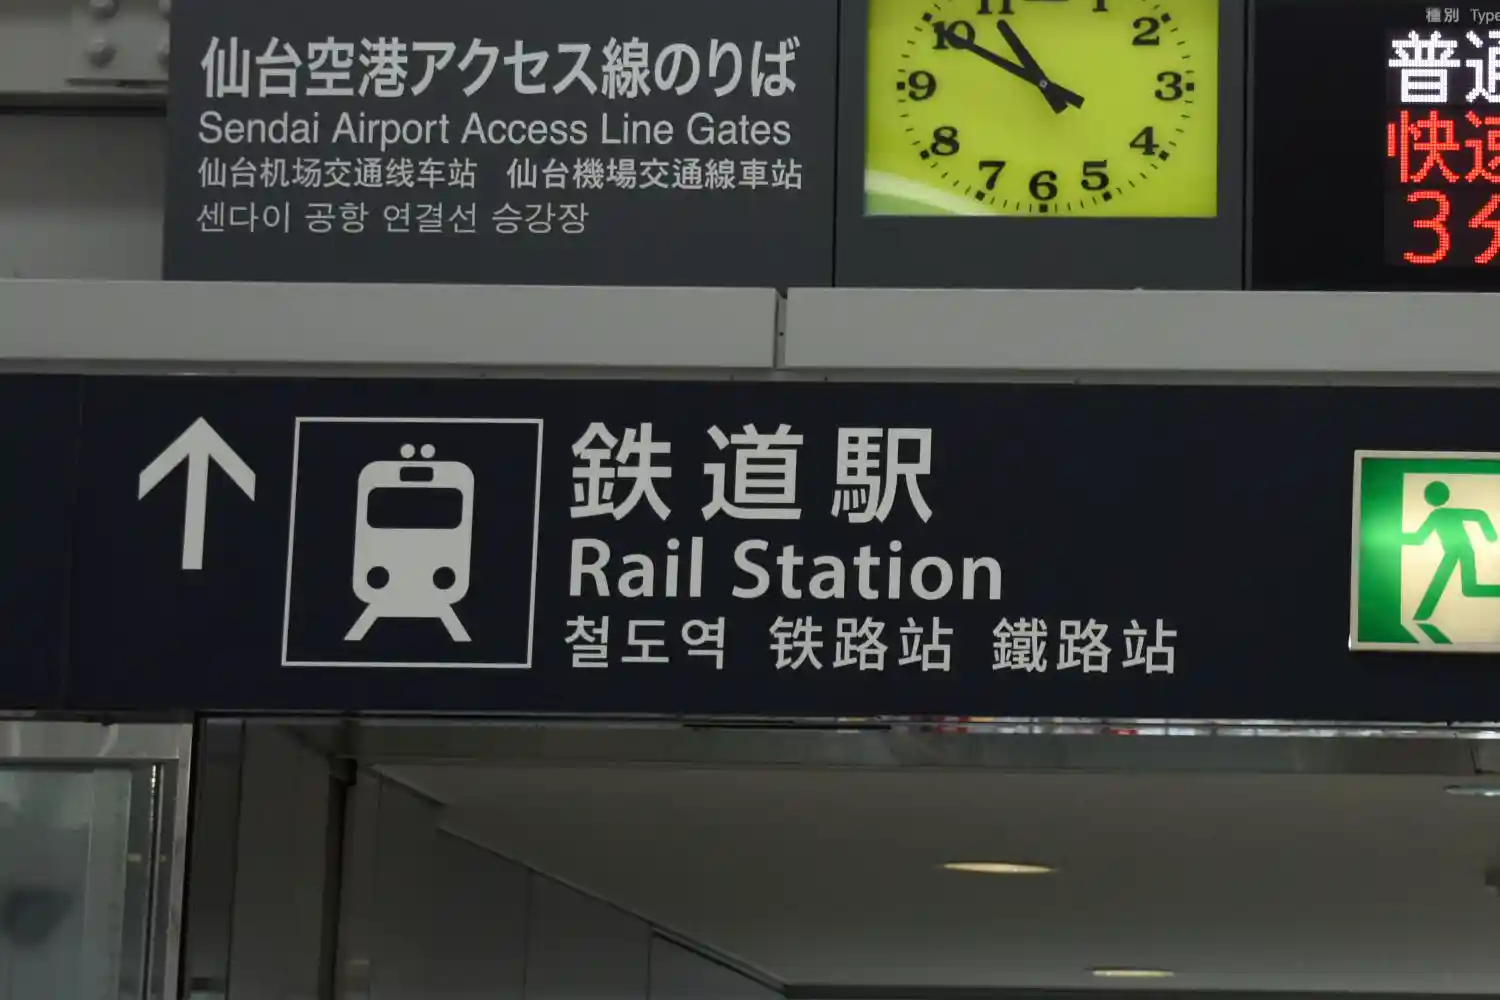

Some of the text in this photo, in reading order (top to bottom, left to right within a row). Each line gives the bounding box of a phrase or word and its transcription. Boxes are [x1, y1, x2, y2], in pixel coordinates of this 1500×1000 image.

[933, 20, 976, 49] 10
[1132, 17, 1160, 46] 2
[201, 36, 800, 99] 仙台空港アクセス線のりば
[908, 71, 936, 100] 9
[1155, 72, 1183, 101] 3
[199, 111, 790, 152] Sendai Airport Access Line Gates
[931, 127, 960, 156] 8
[1129, 127, 1159, 156] 4
[198, 157, 802, 189] 仙台机场交通线车站 仙台機場交通線車站
[978, 161, 1006, 190] 7
[1029, 171, 1058, 200] 6
[1081, 160, 1109, 191] 5
[197, 202, 589, 233] 센다이 공항 연결선 승강장
[570, 422, 932, 523] 鉄道駅
[570, 537, 1001, 600] Rail Station
[565, 616, 1177, 673] 철도역 铁路站 鐵路站
